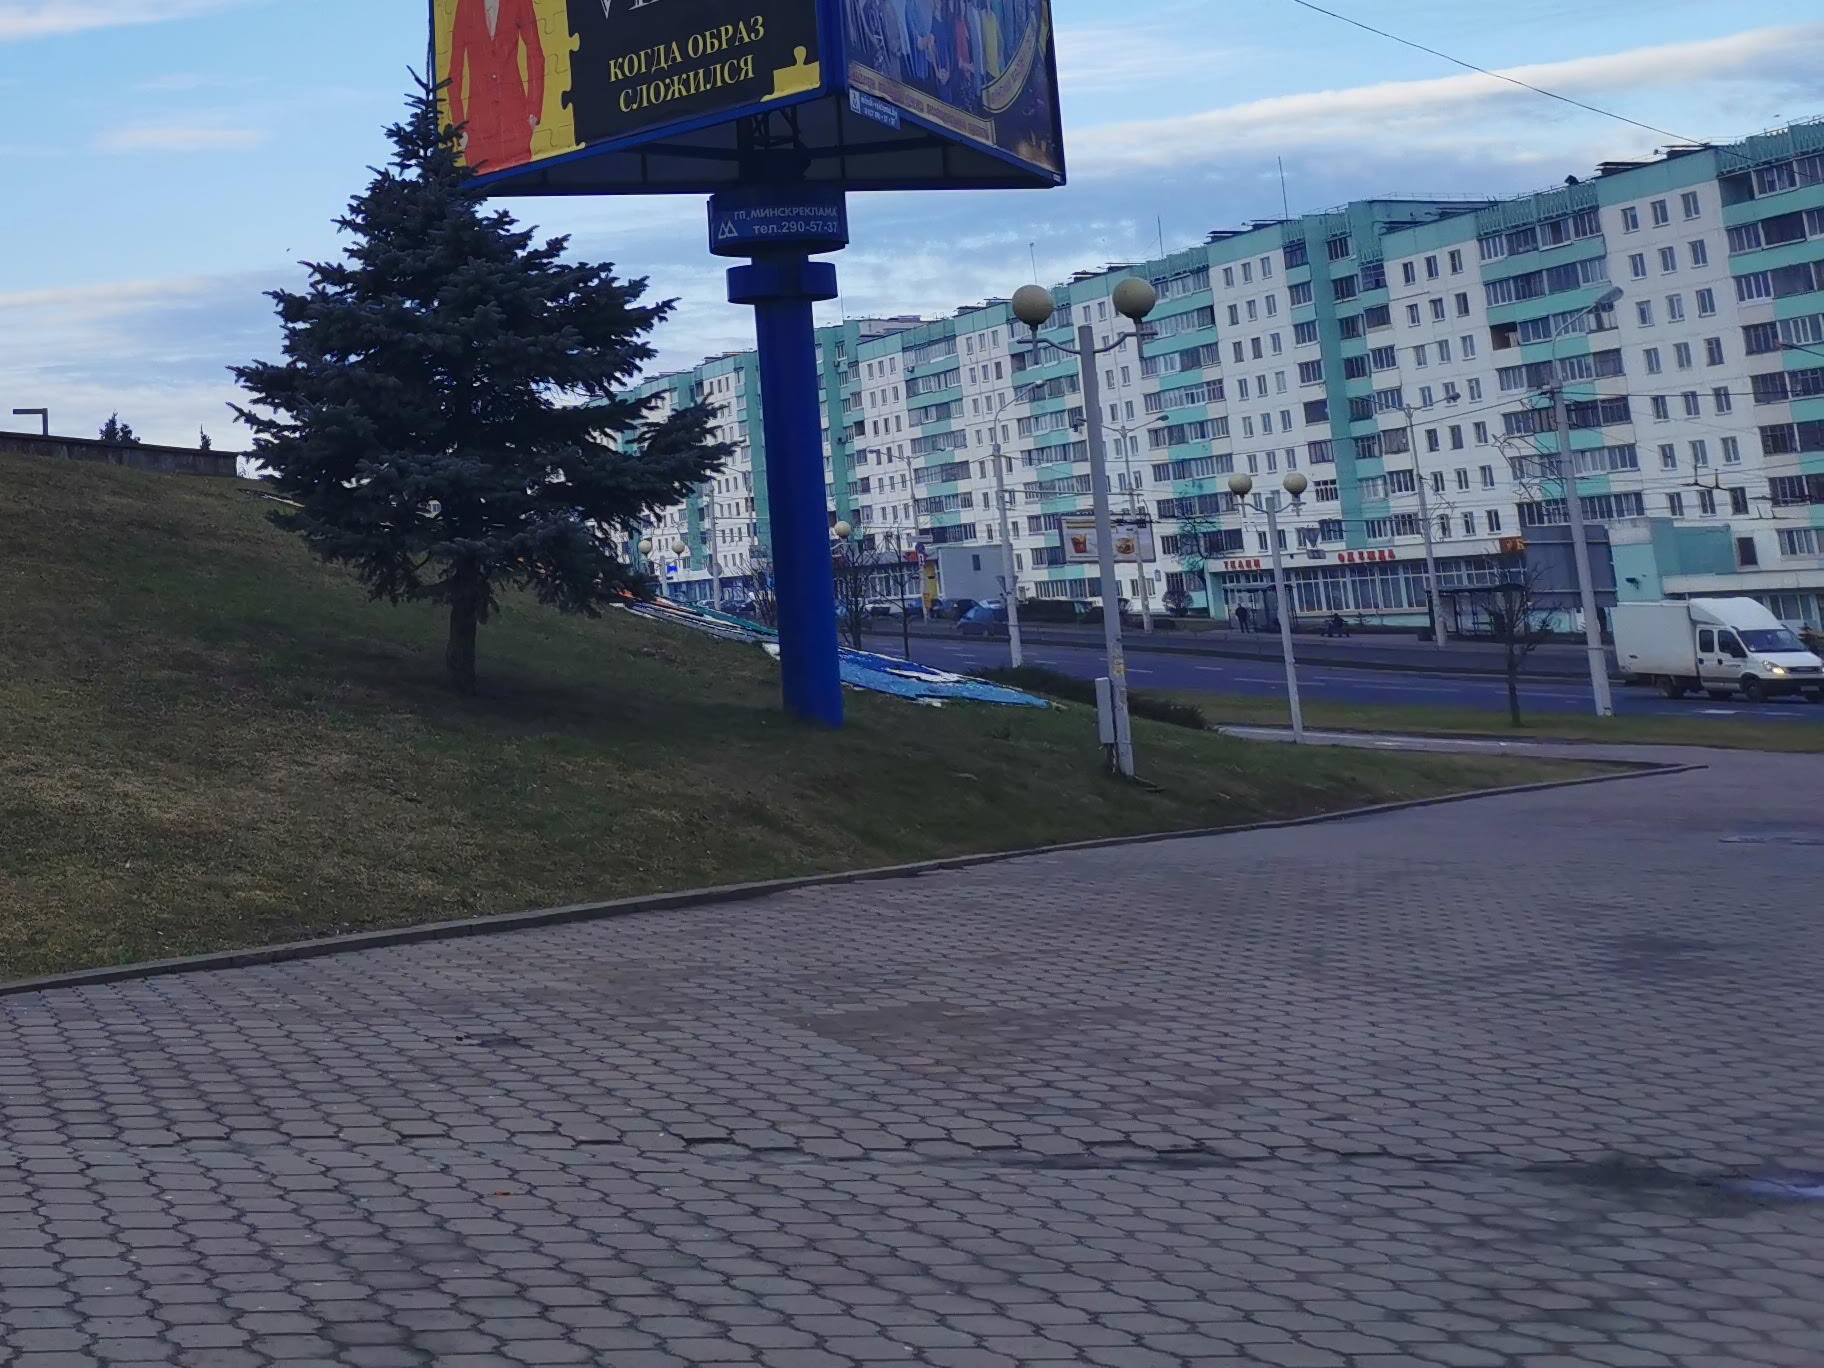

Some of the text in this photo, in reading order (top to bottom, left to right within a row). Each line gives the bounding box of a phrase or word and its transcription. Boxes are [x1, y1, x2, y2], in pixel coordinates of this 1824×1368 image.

[608, 15, 764, 83] КОГДА ОБРАЗ
[619, 54, 755, 113] СЛОЖИЛСЯ
